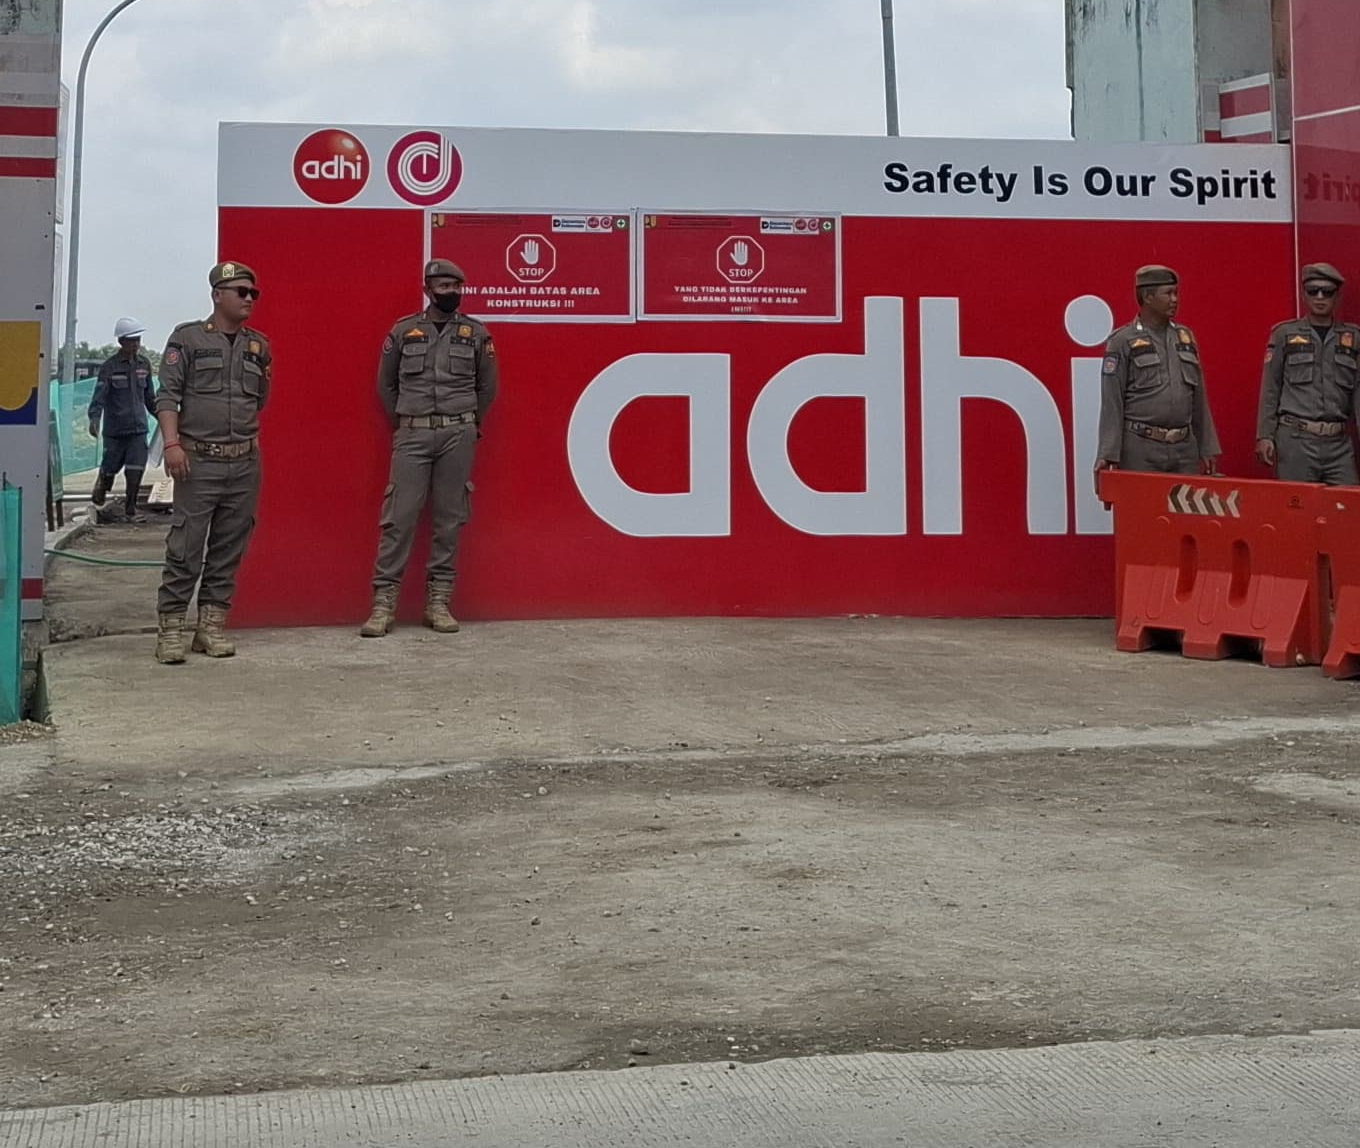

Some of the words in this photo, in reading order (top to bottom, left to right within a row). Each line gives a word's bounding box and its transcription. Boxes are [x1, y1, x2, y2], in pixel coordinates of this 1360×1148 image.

[301, 154, 363, 181] adhi
[883, 163, 1018, 202] Safety
[1033, 166, 1069, 196] Is
[1084, 167, 1156, 197] Our
[1169, 168, 1277, 205] Spirit
[519, 268, 545, 277] STOP
[729, 269, 753, 277] STOP
[481, 286, 526, 295] ADALAH
[530, 287, 567, 295] BATAS
[570, 287, 600, 295] AREA
[487, 300, 561, 308] KONSTRUKSI
[567, 295, 1115, 536] adhi
